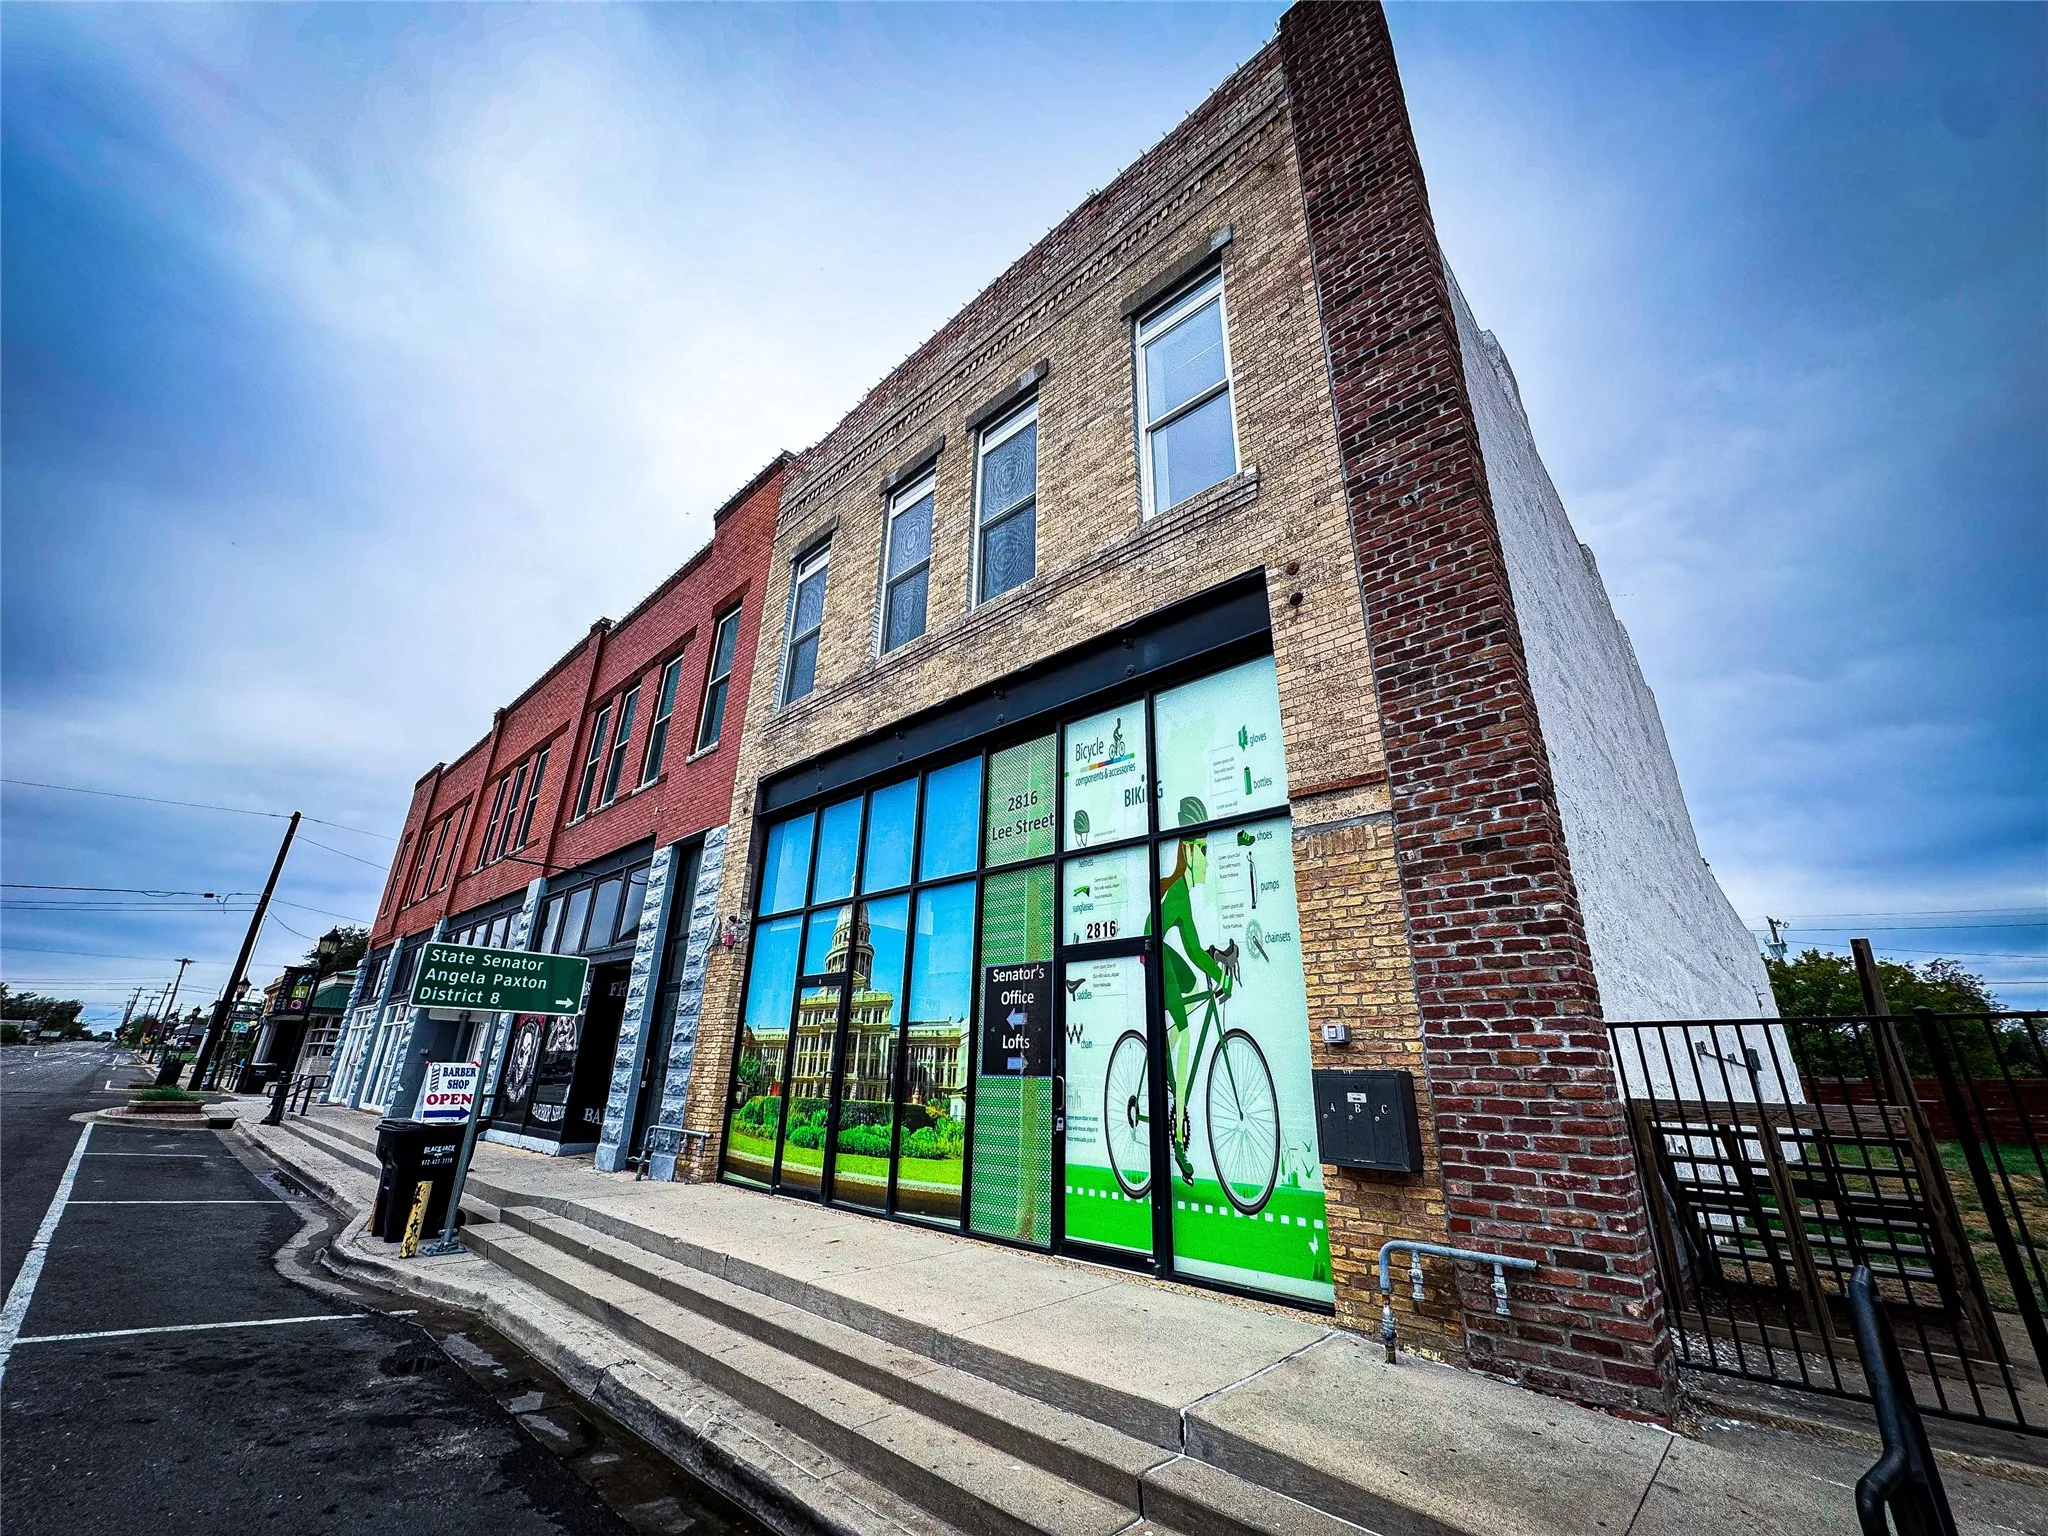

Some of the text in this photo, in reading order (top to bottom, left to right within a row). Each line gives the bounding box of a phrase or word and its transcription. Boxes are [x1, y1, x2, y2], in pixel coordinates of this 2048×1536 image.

[1249, 733, 1267, 746] gloves
[1075, 737, 1104, 763] Bicycle
[1075, 771, 1105, 787] components
[1108, 762, 1136, 778] accessories
[1253, 776, 1272, 789] bottles
[1124, 774, 1163, 808] BIKiG
[1007, 790, 1038, 812] 2816
[992, 814, 1055, 841] Lee Street
[1256, 830, 1273, 841] shoes
[1260, 880, 1279, 893] pumps
[1072, 902, 1094, 914] sunglasses
[1086, 920, 1117, 939] 2816
[1264, 932, 1291, 944] chainsets
[430, 949, 544, 971] State Senator
[425, 968, 547, 990] Angela Paxton
[992, 964, 1045, 983] Senator's
[419, 987, 500, 1004] District 8
[1001, 990, 1034, 1005] Office
[1002, 1033, 1030, 1049] Lofts
[443, 1067, 476, 1077] BARBER
[447, 1079, 470, 1089] SHOP
[426, 1093, 473, 1105] OPEN
[1330, 1102, 1336, 1112] A
[1354, 1103, 1361, 1113] B
[1381, 1104, 1388, 1114] C
[583, 1107, 607, 1125] BA
